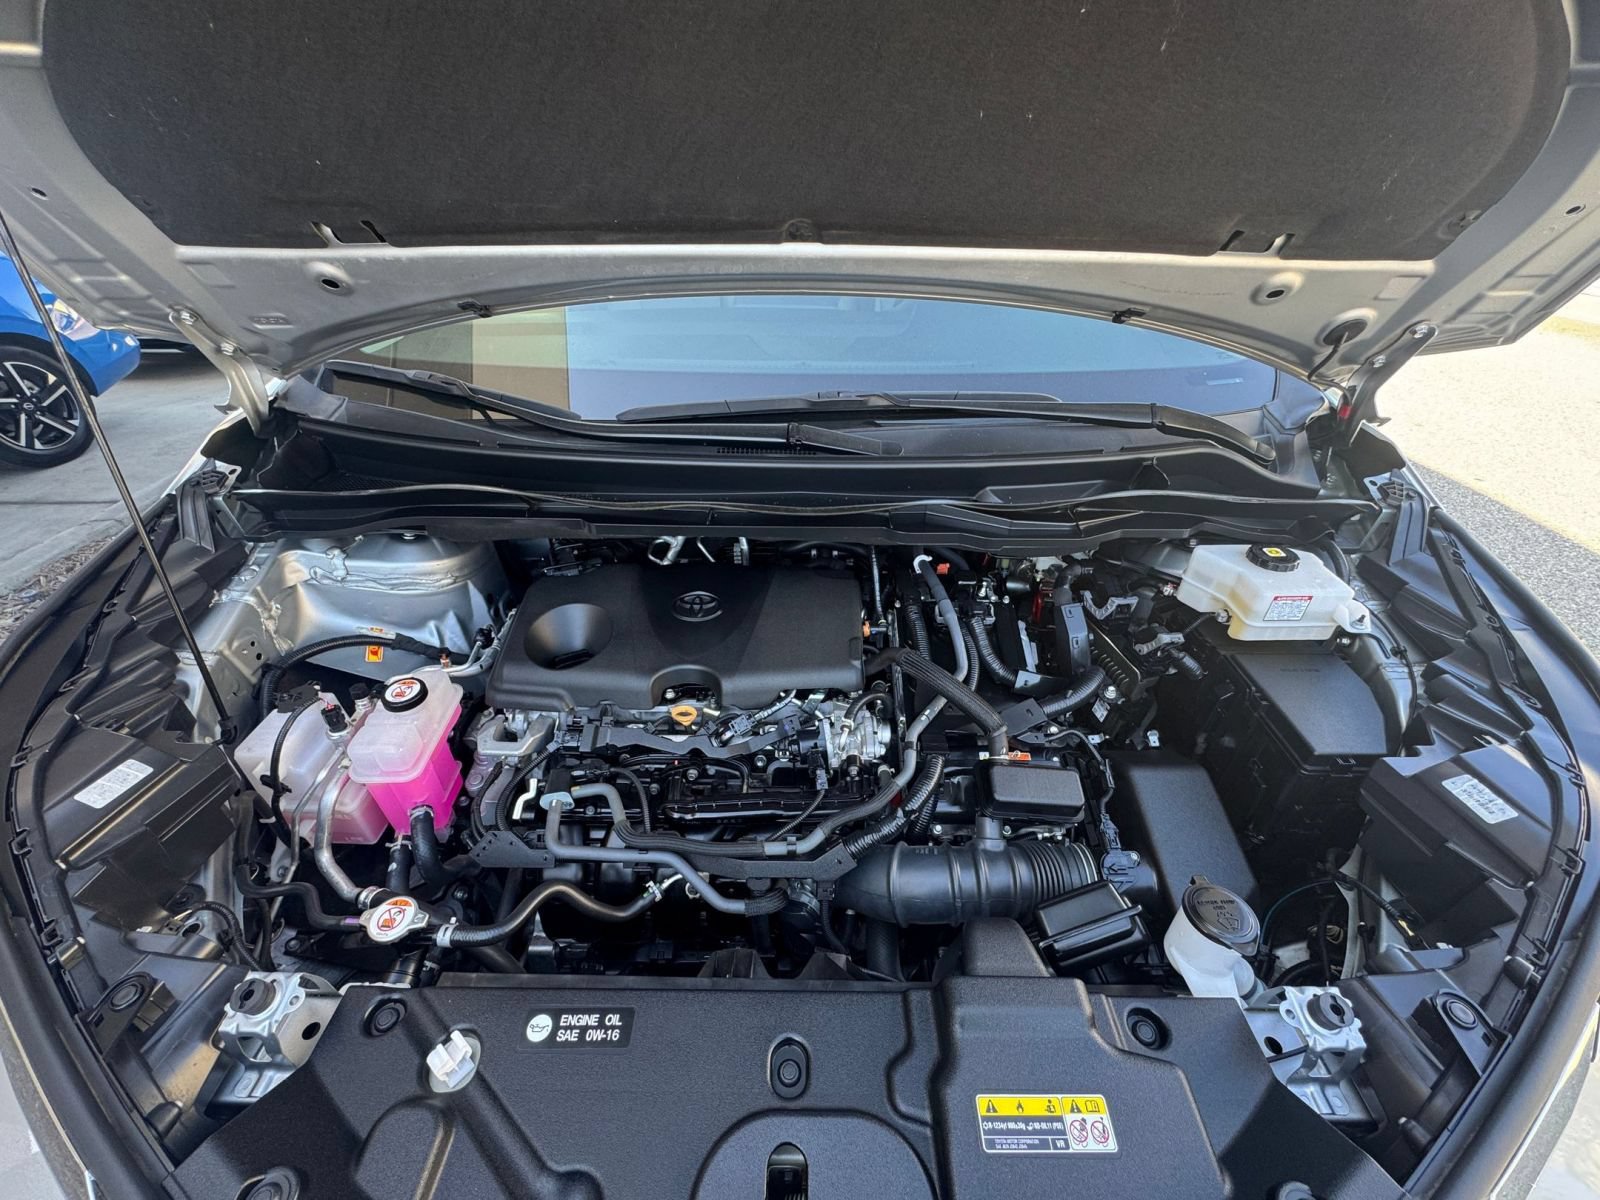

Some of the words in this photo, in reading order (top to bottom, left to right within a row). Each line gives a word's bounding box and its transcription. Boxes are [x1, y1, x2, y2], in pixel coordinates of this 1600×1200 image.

[559, 1014, 600, 1026] ENGINE
[604, 1013, 623, 1026] OIL
[556, 1029, 580, 1042] SAE
[585, 1029, 620, 1042] 0W-16
